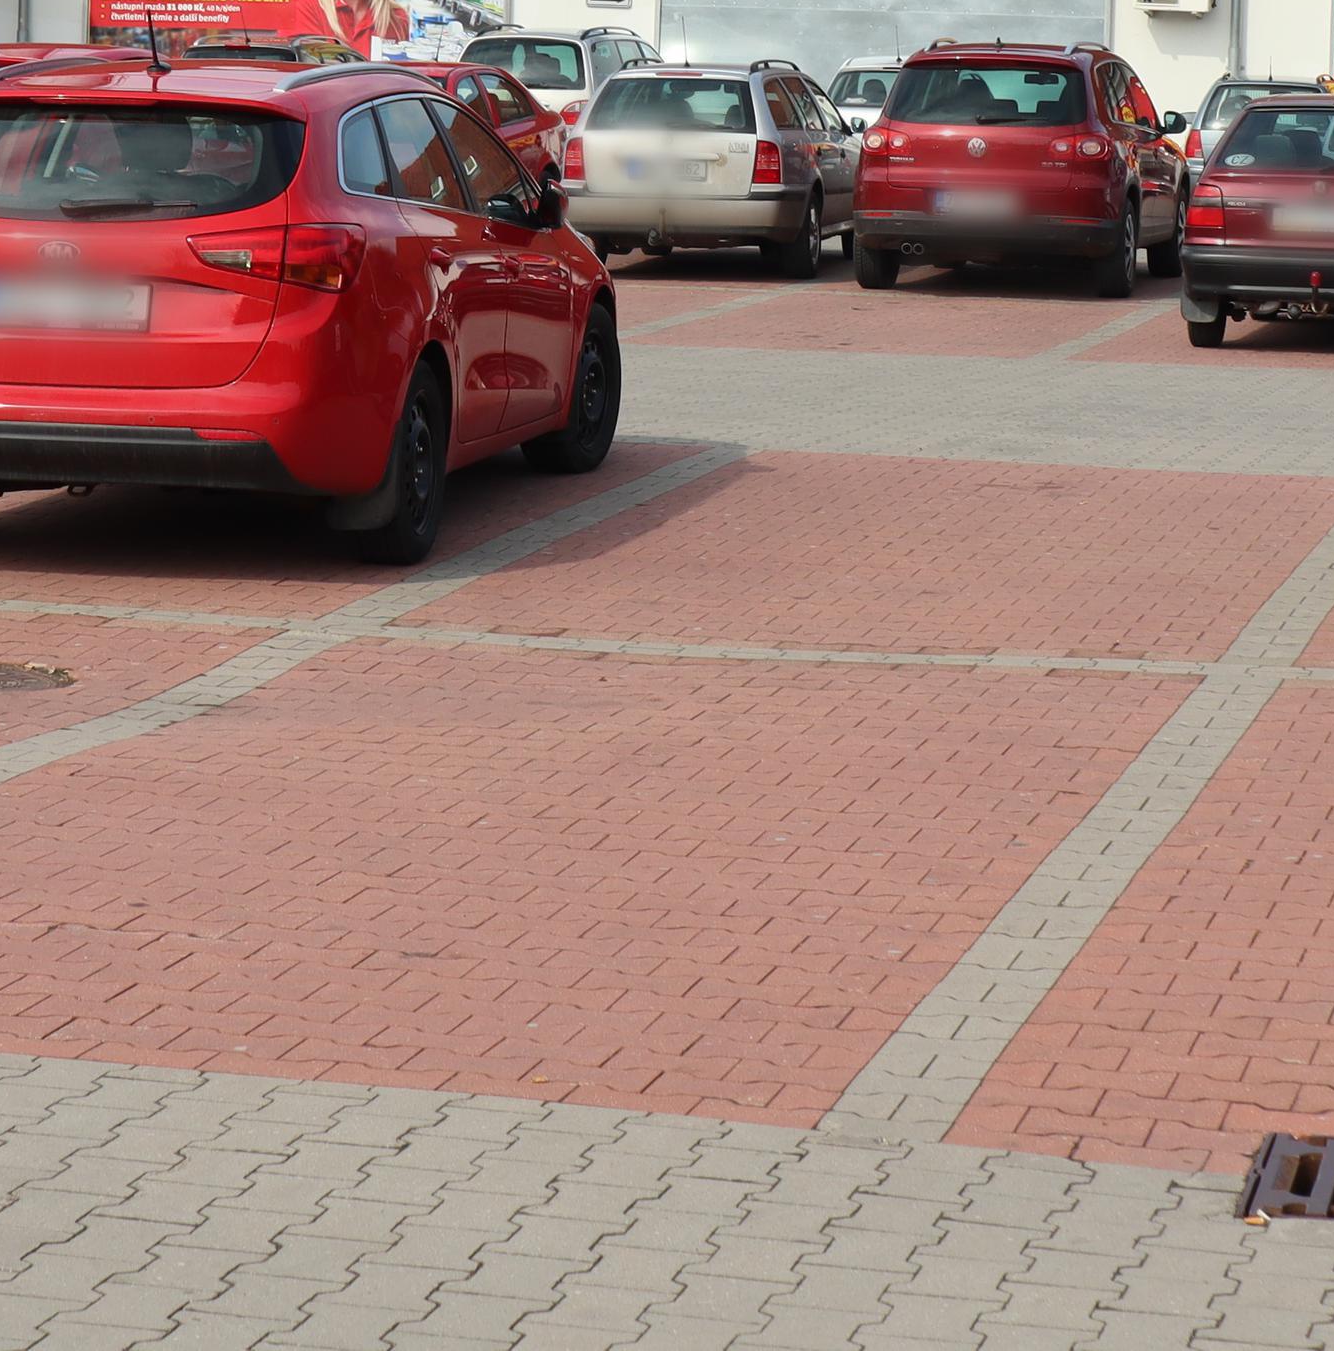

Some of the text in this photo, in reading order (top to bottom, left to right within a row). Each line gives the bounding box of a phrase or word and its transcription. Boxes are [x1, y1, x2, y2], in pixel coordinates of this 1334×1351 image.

[111, 2, 144, 12] nástupní
[145, 3, 165, 11] mzda
[198, 14, 229, 23] benefity
[1230, 155, 1249, 165] CZ
